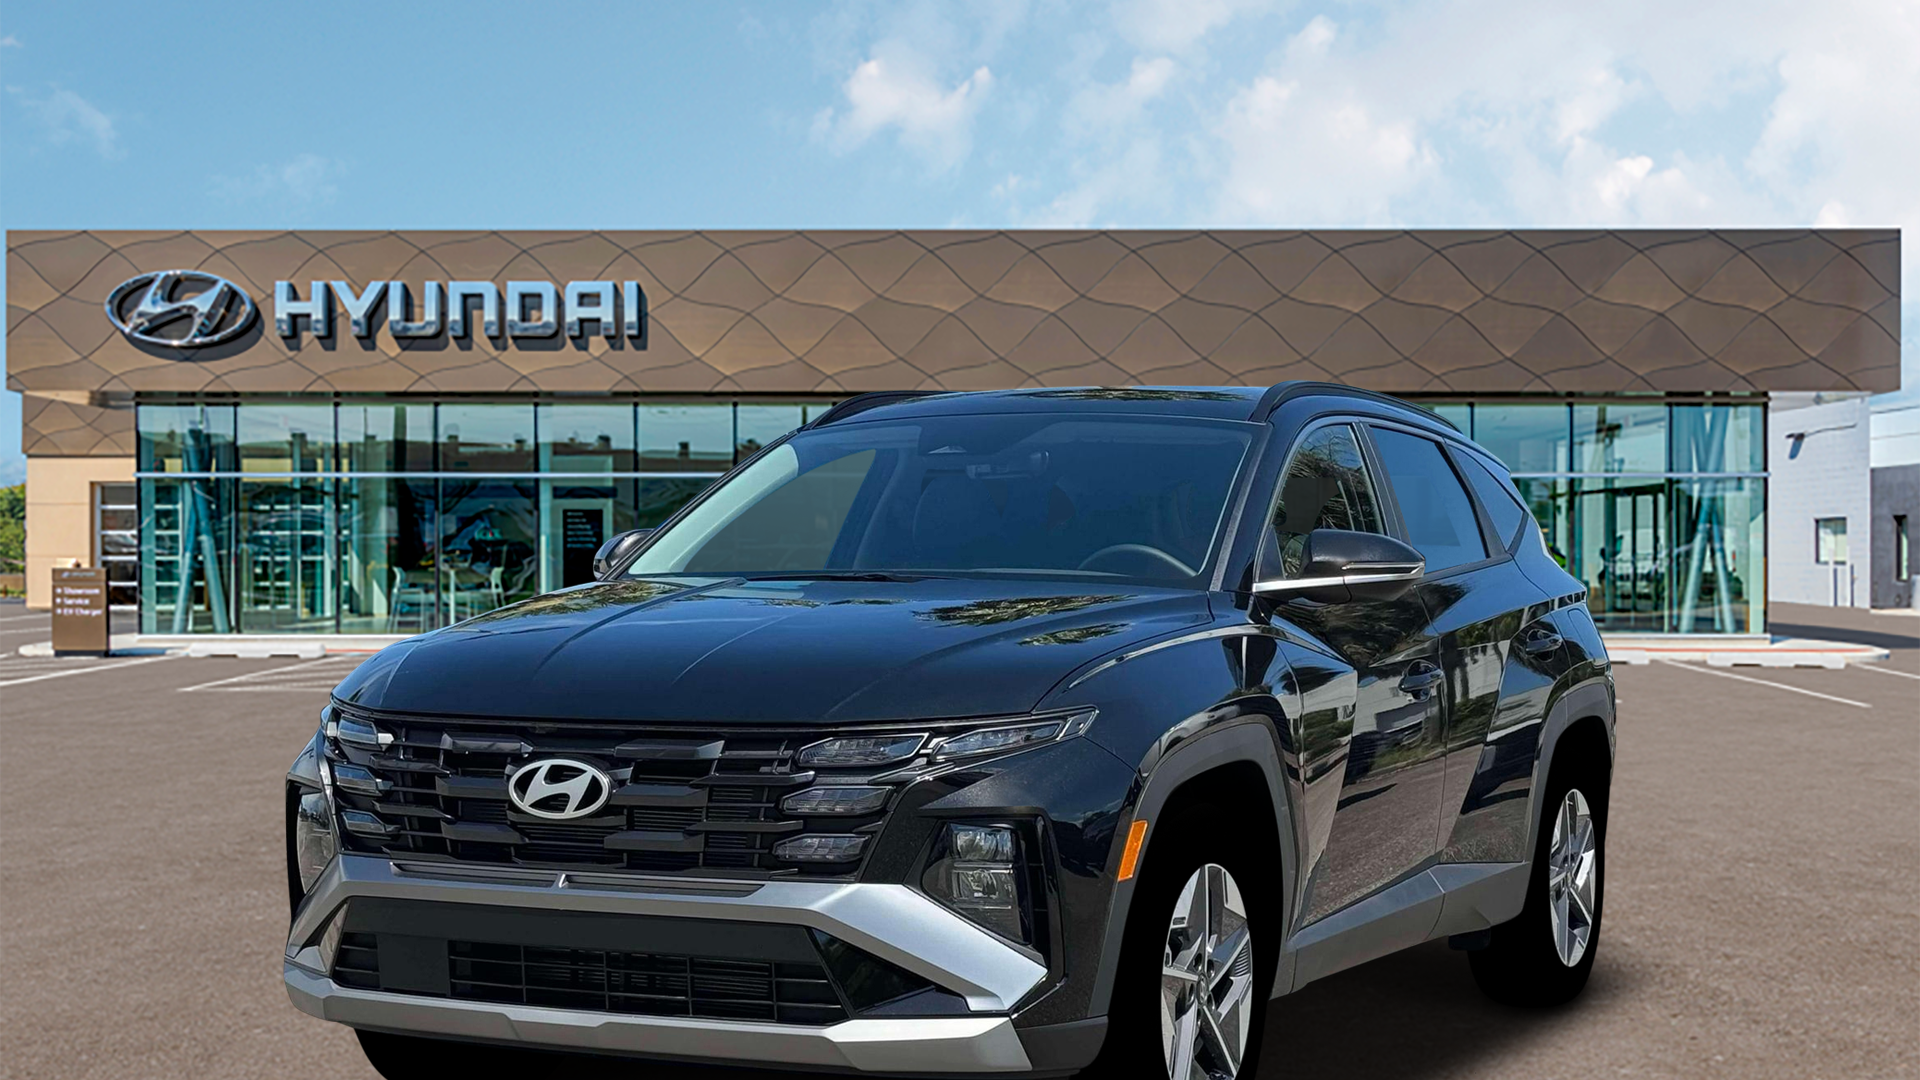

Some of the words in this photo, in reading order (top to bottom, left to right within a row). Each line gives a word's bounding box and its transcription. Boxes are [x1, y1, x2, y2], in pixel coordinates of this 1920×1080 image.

[274, 280, 645, 340] HYUNDAI
[63, 587, 100, 595] Showroom
[63, 597, 90, 605] Service
[75, 608, 102, 617] Charger
